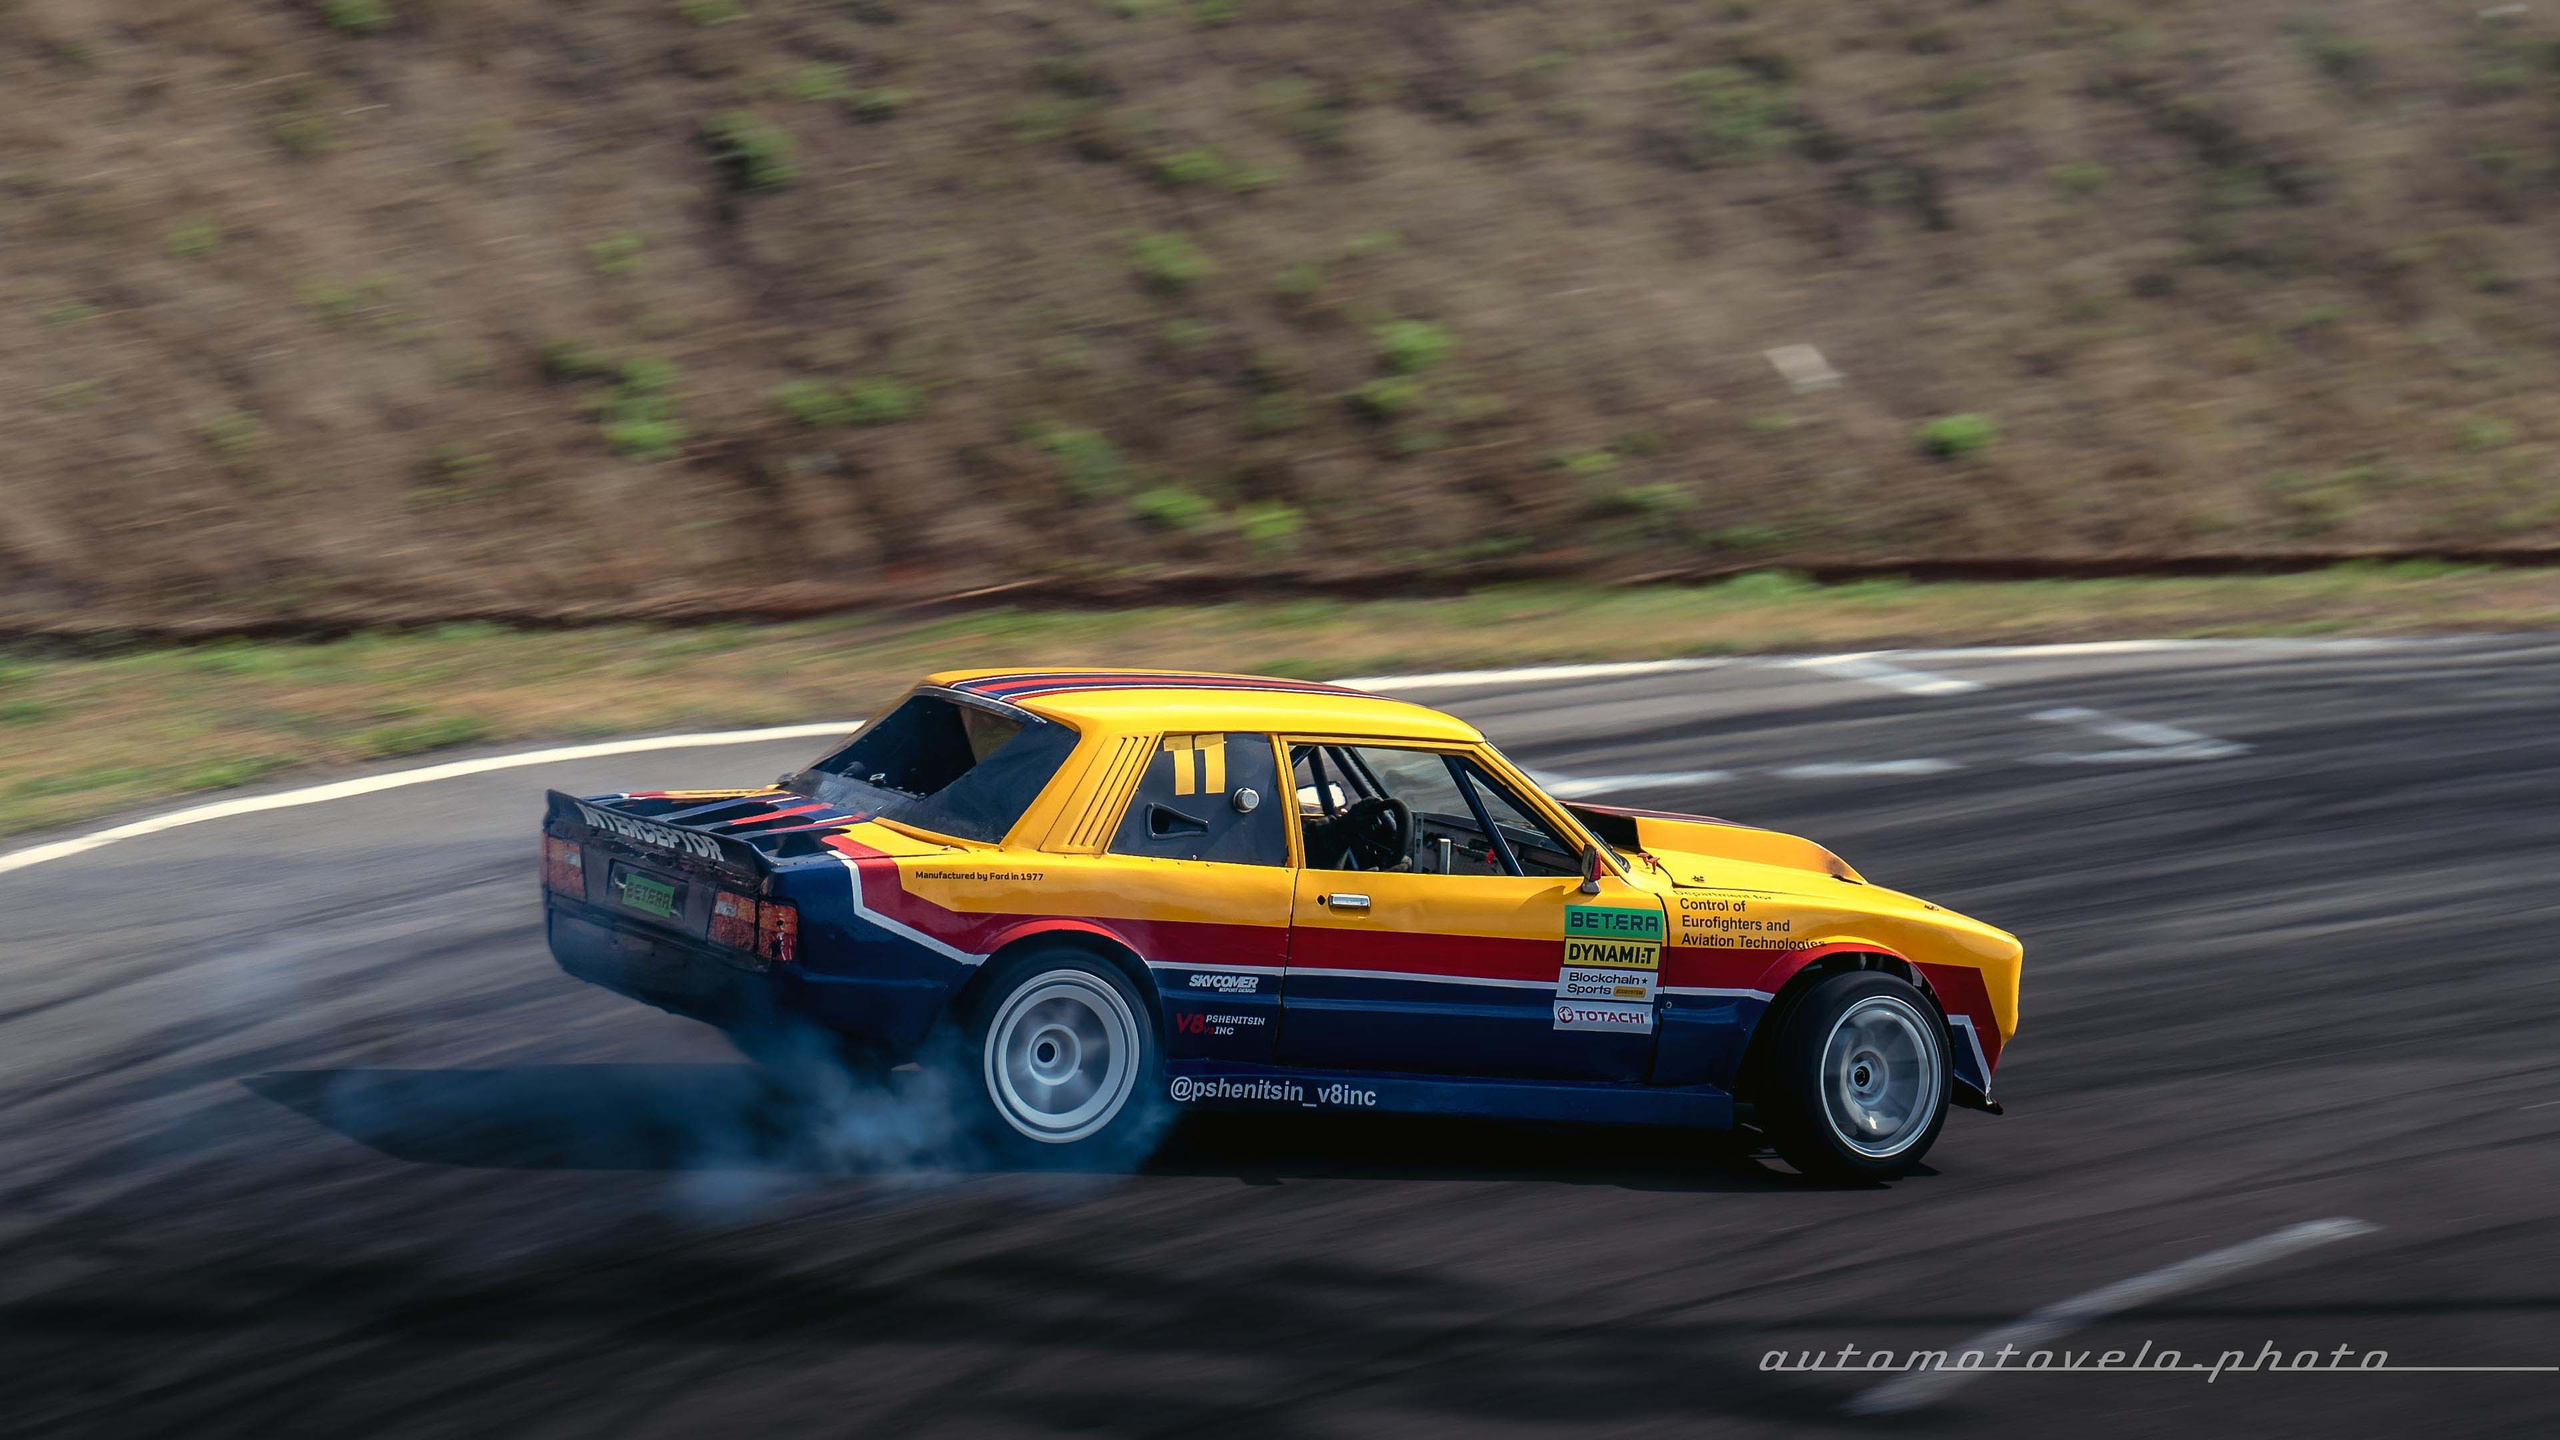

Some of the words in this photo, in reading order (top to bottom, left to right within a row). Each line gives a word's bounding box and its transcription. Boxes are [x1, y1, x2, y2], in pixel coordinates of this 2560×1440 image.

[1163, 733, 1226, 796] 11
[574, 801, 725, 862] INTERCEPTOR
[915, 871, 976, 881] Manufactured
[977, 872, 988, 882] by
[989, 872, 1009, 881] Ford
[1011, 873, 1019, 881] in
[1020, 873, 1044, 881] 1977
[1680, 898, 1729, 912] Control
[1733, 901, 1746, 912] of
[1682, 915, 1763, 932] Eurofighters
[1766, 919, 1790, 932] and
[1681, 933, 1735, 948] Aviation
[1738, 935, 1826, 951] Technologies
[1188, 974, 1259, 988] SKYCOMER
[1568, 972, 1640, 985] Blockchain
[1567, 983, 1612, 995] Sports
[1176, 1013, 1205, 1034] V8
[1205, 1014, 1266, 1026] PSHENITSIN
[1575, 1010, 1645, 1024] TOTACHI
[1170, 1075, 1377, 1108] @pshenitsin_v8inc
